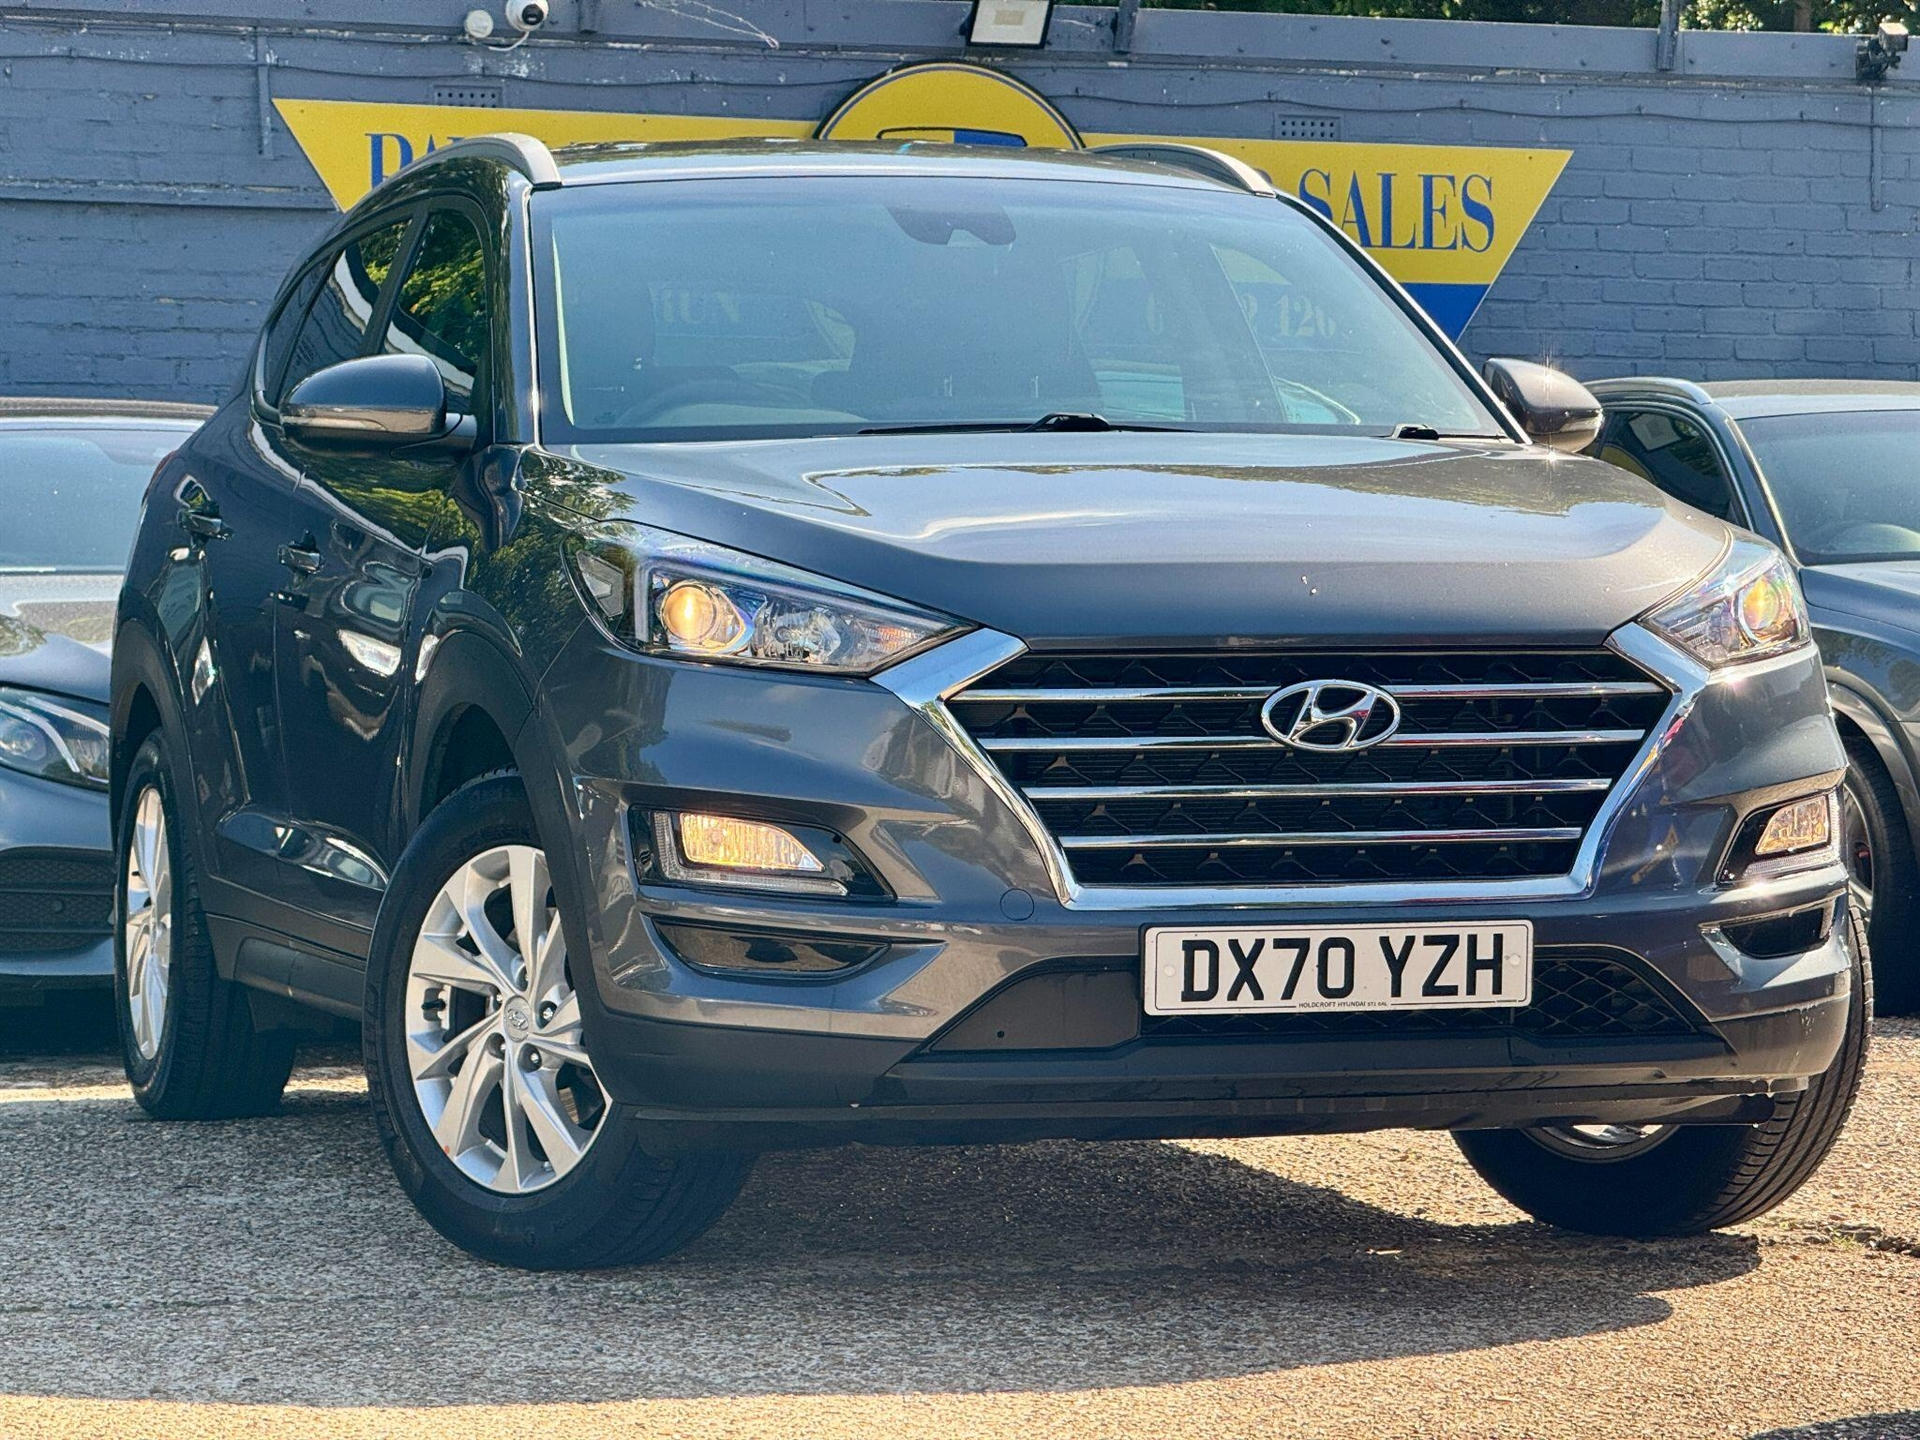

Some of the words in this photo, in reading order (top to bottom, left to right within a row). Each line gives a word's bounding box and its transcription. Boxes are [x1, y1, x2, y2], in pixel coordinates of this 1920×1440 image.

[1299, 168, 1495, 253] SALES
[1181, 936, 1356, 1002] DX70
[1379, 932, 1504, 998] YZH
[1298, 1001, 1336, 1009] HOLDCROFT
[1337, 1000, 1366, 1008] HYUNDAI
